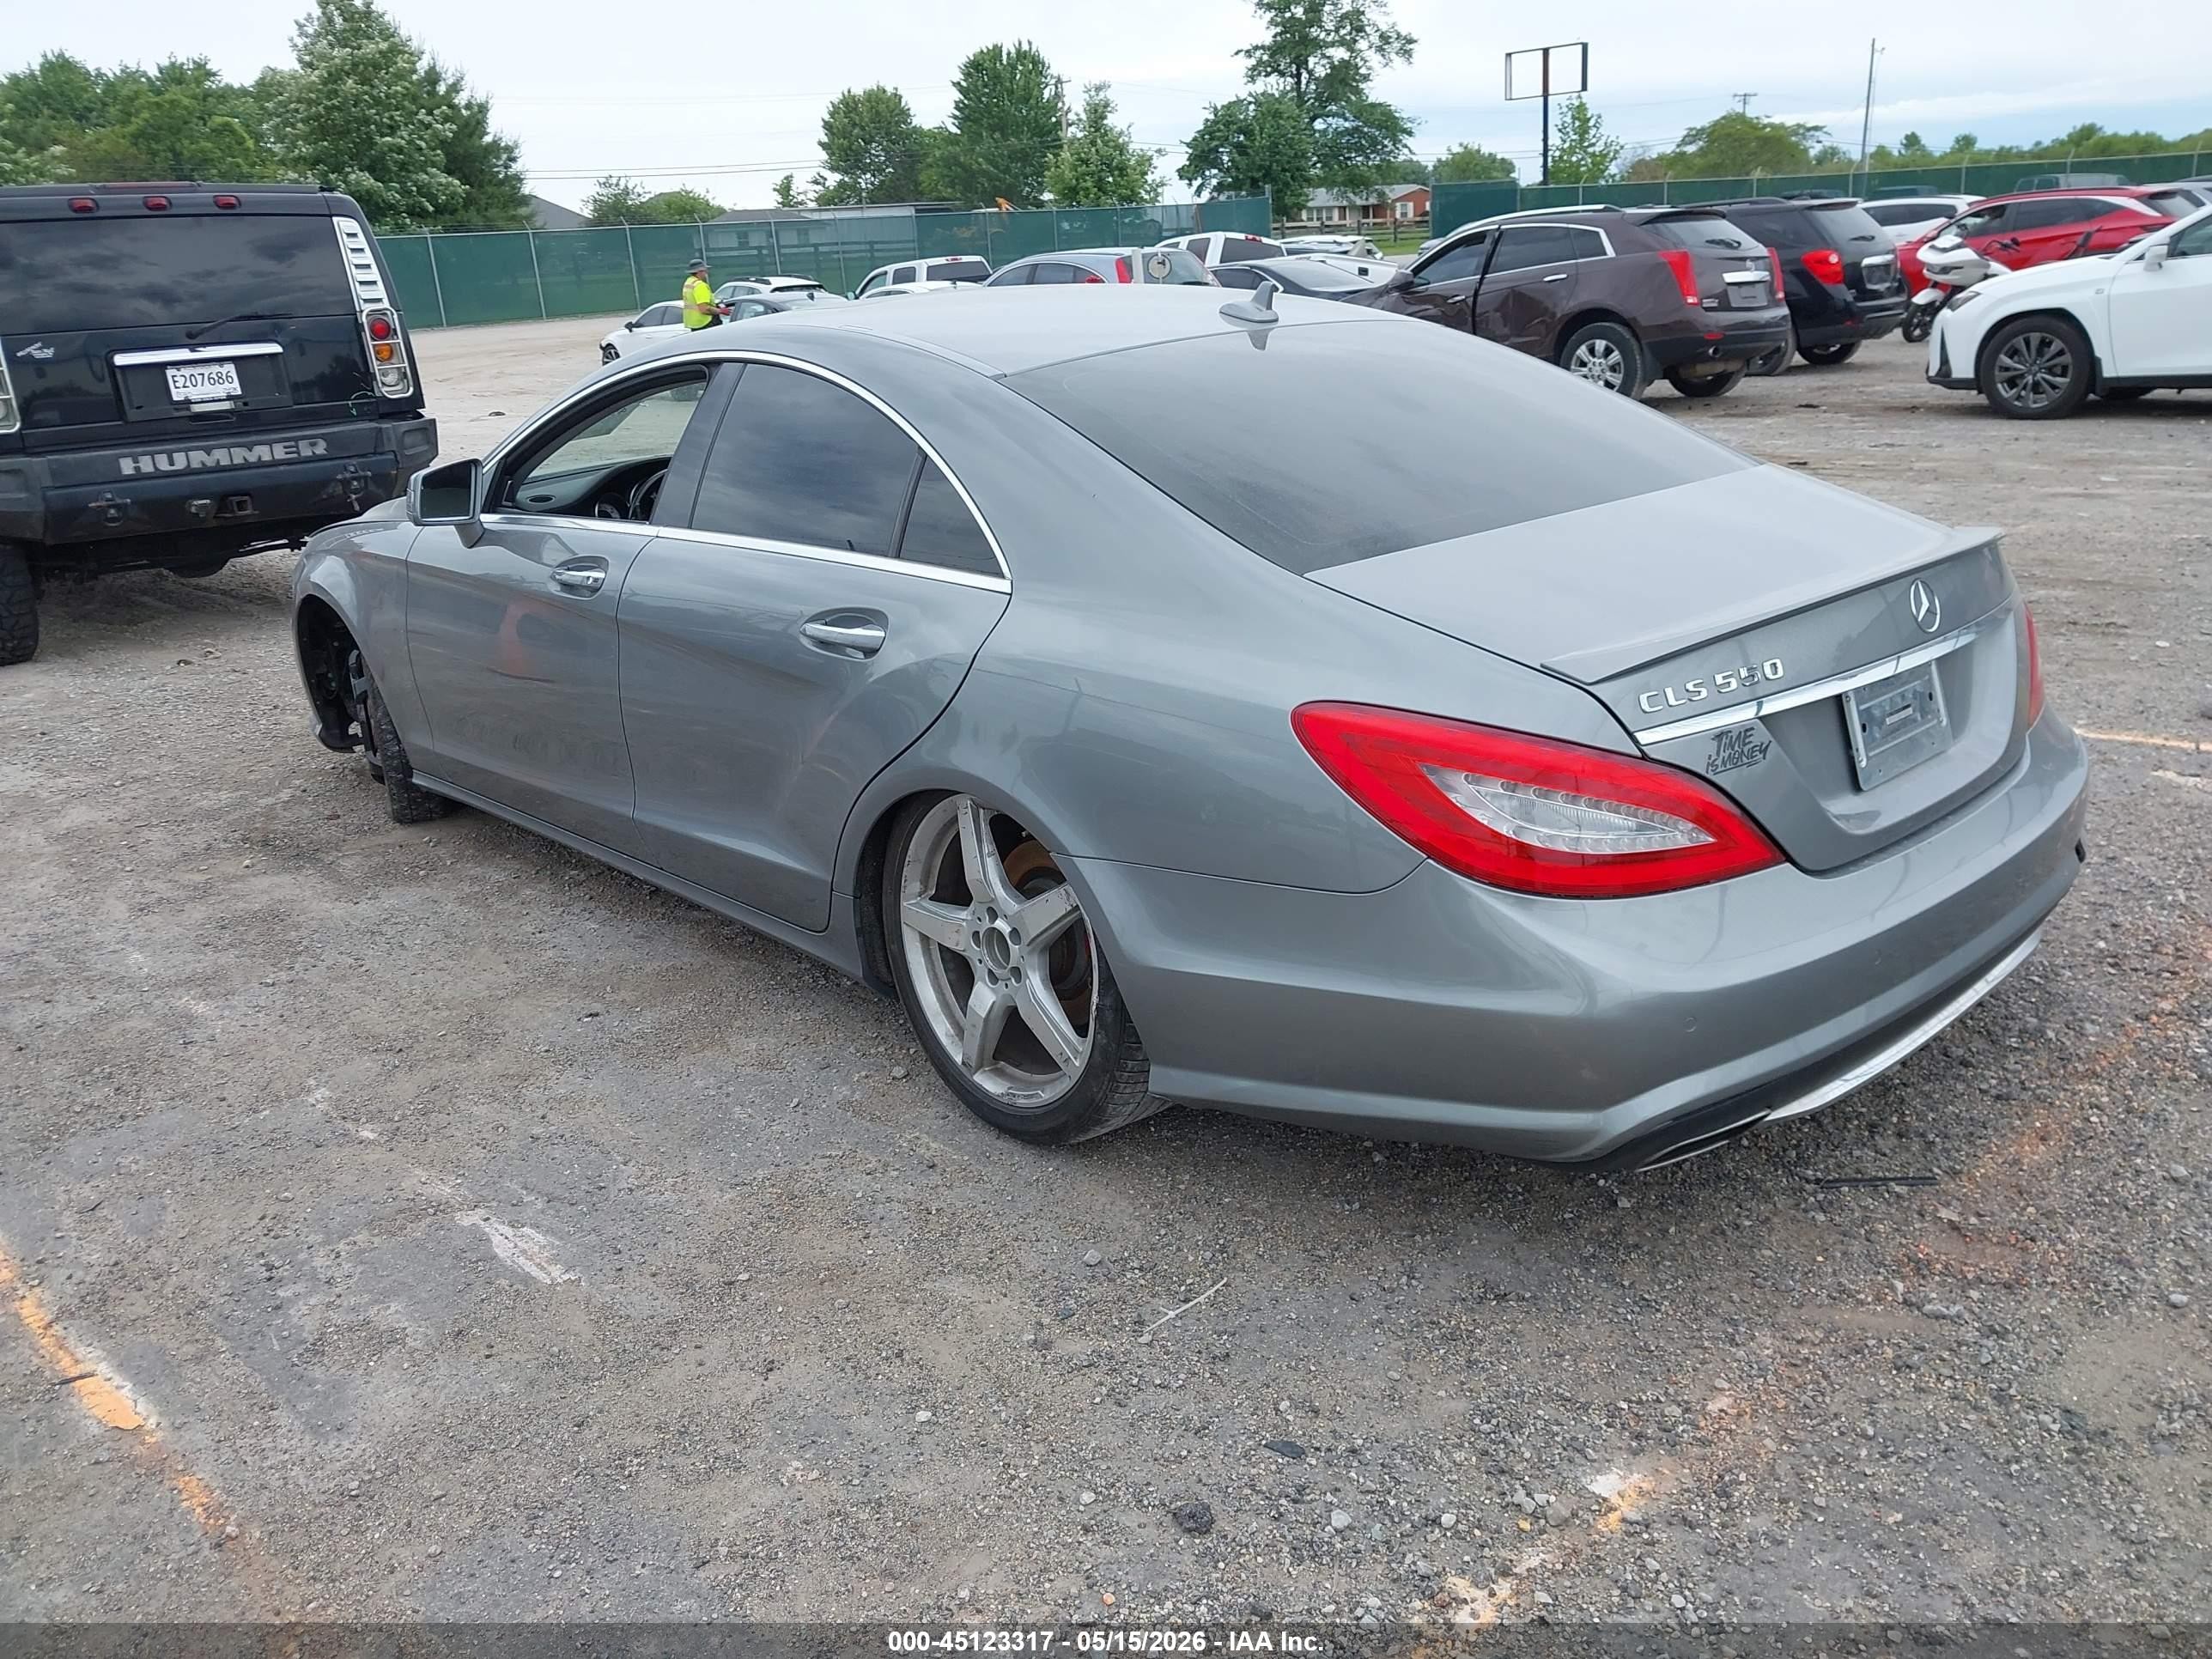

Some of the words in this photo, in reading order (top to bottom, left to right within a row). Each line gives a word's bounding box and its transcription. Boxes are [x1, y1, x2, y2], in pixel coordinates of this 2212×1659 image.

[171, 370, 234, 390] E207686
[118, 438, 328, 474] HUMMER
[1638, 679, 1709, 714] CLS
[1713, 658, 1784, 694] 550
